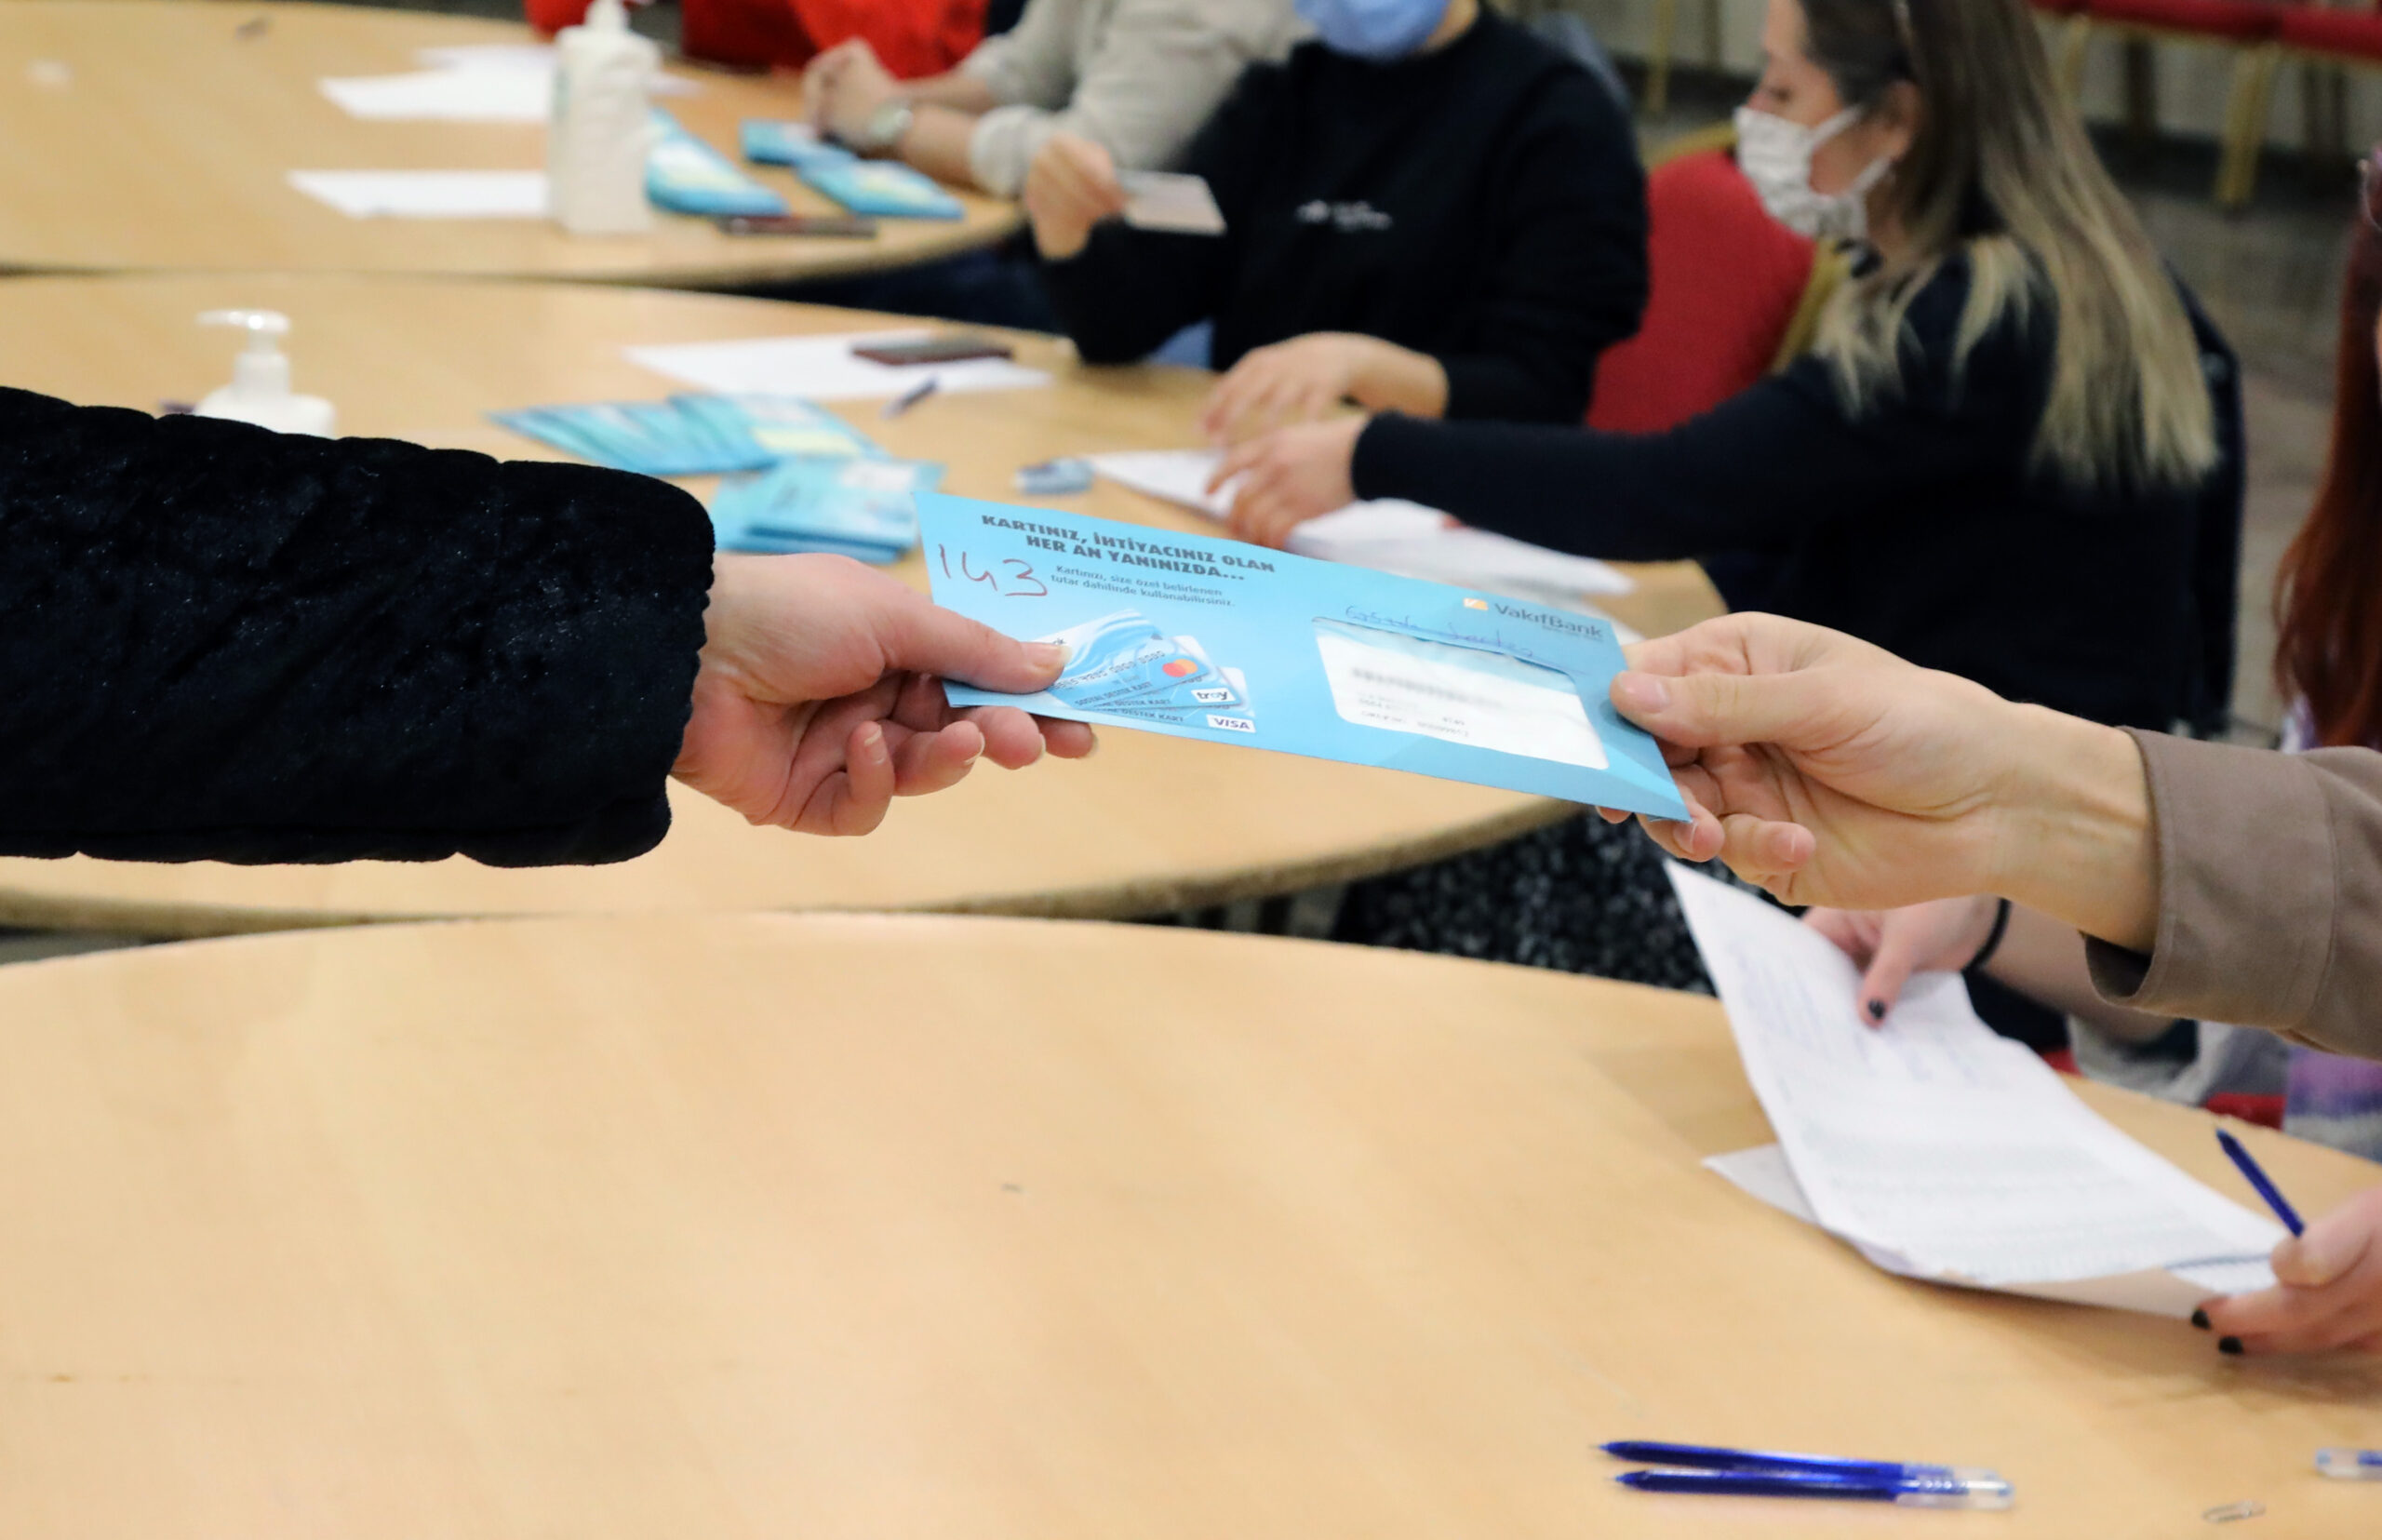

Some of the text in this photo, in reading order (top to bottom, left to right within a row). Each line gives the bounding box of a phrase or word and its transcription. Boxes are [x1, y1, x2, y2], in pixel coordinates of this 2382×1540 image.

[982, 515, 1276, 573] KARTINIZ, İHTİYACINIZ OLAN
[1026, 534, 1245, 581] HER AN YANINIZDA...
[938, 542, 1048, 597] 143
[1050, 574, 1079, 586] tutar
[1082, 579, 1137, 596] dahilinde
[1110, 574, 1133, 586] size
[1163, 582, 1224, 596] belirlenen
[1213, 717, 1251, 730] VISA
